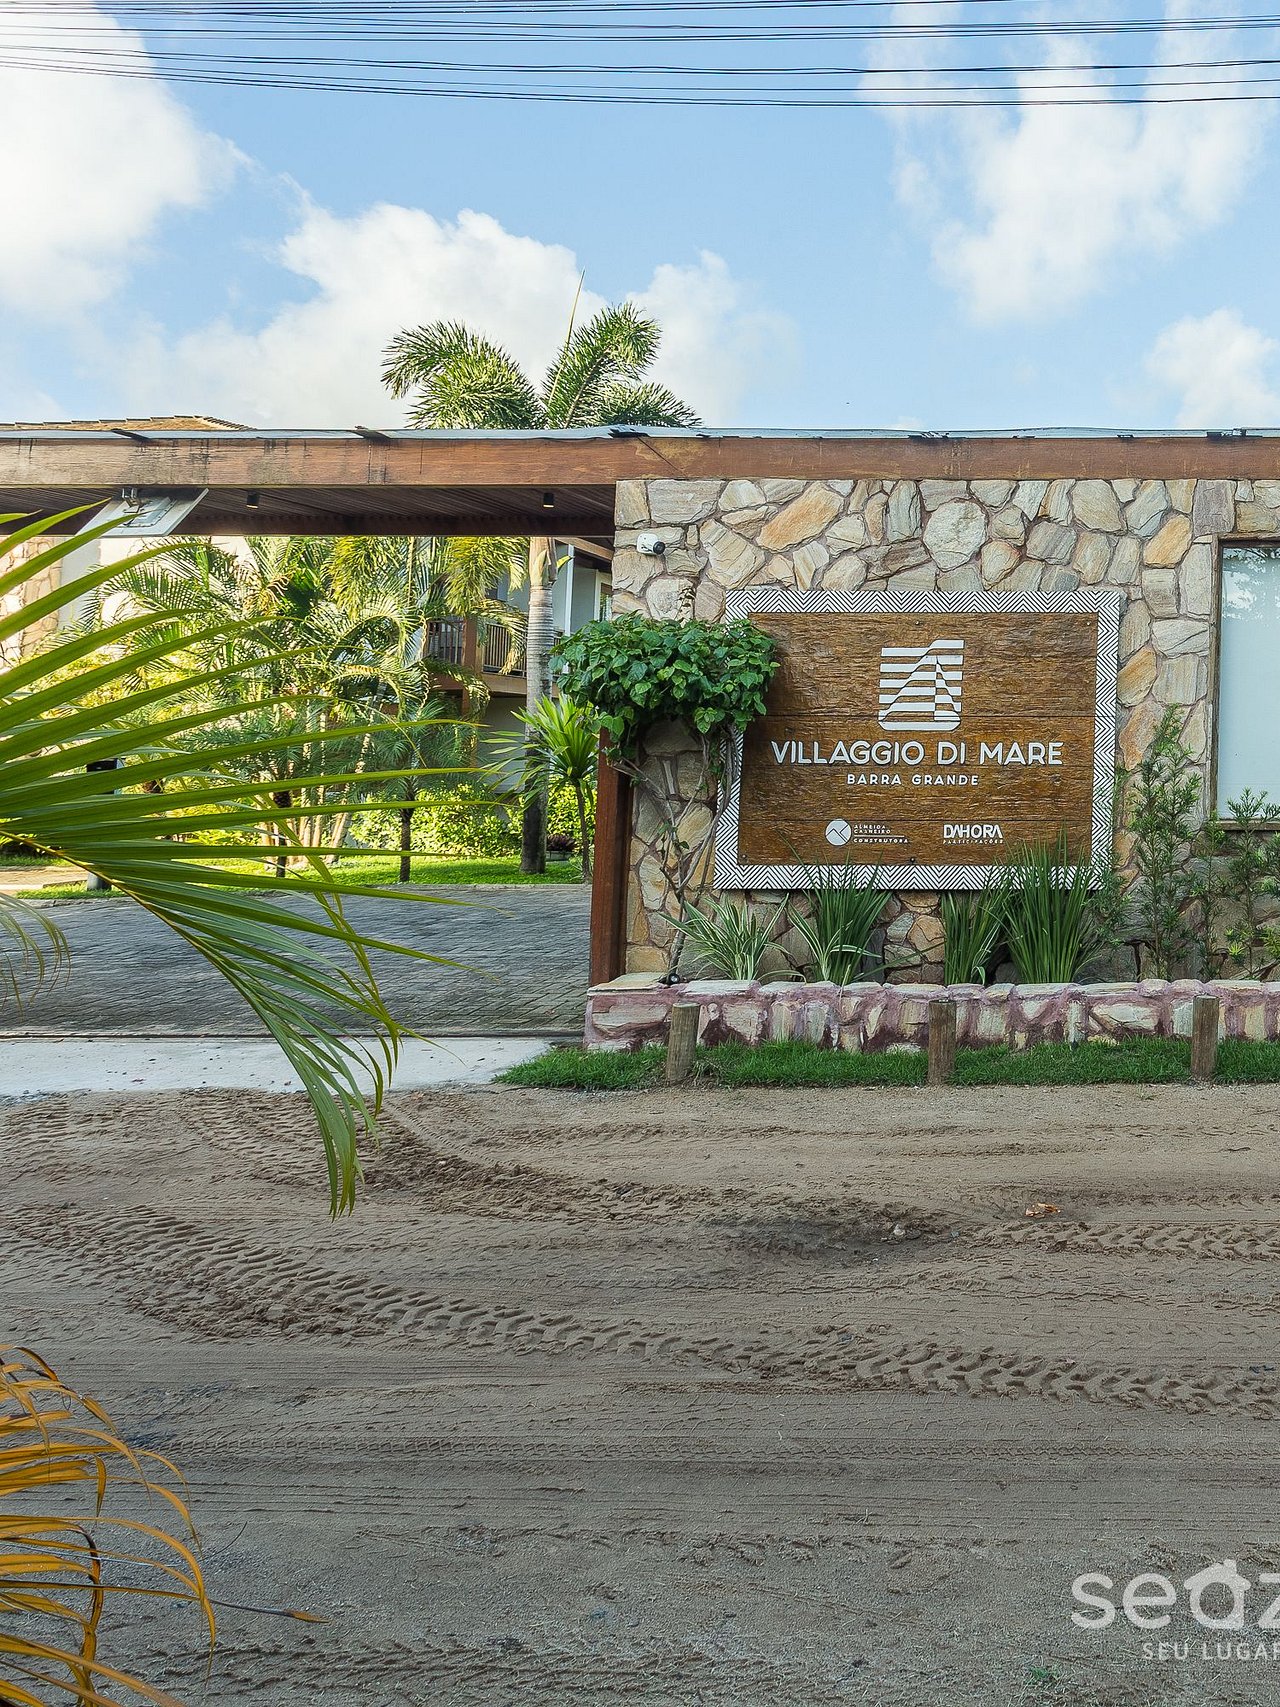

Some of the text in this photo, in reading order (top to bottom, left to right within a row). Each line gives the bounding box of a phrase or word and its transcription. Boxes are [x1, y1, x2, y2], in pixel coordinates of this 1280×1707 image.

[770, 740, 1064, 766] VILLAGGIO DI MARE
[847, 773, 979, 787] BARRA GRANDE
[943, 824, 1003, 839] DAHORA
